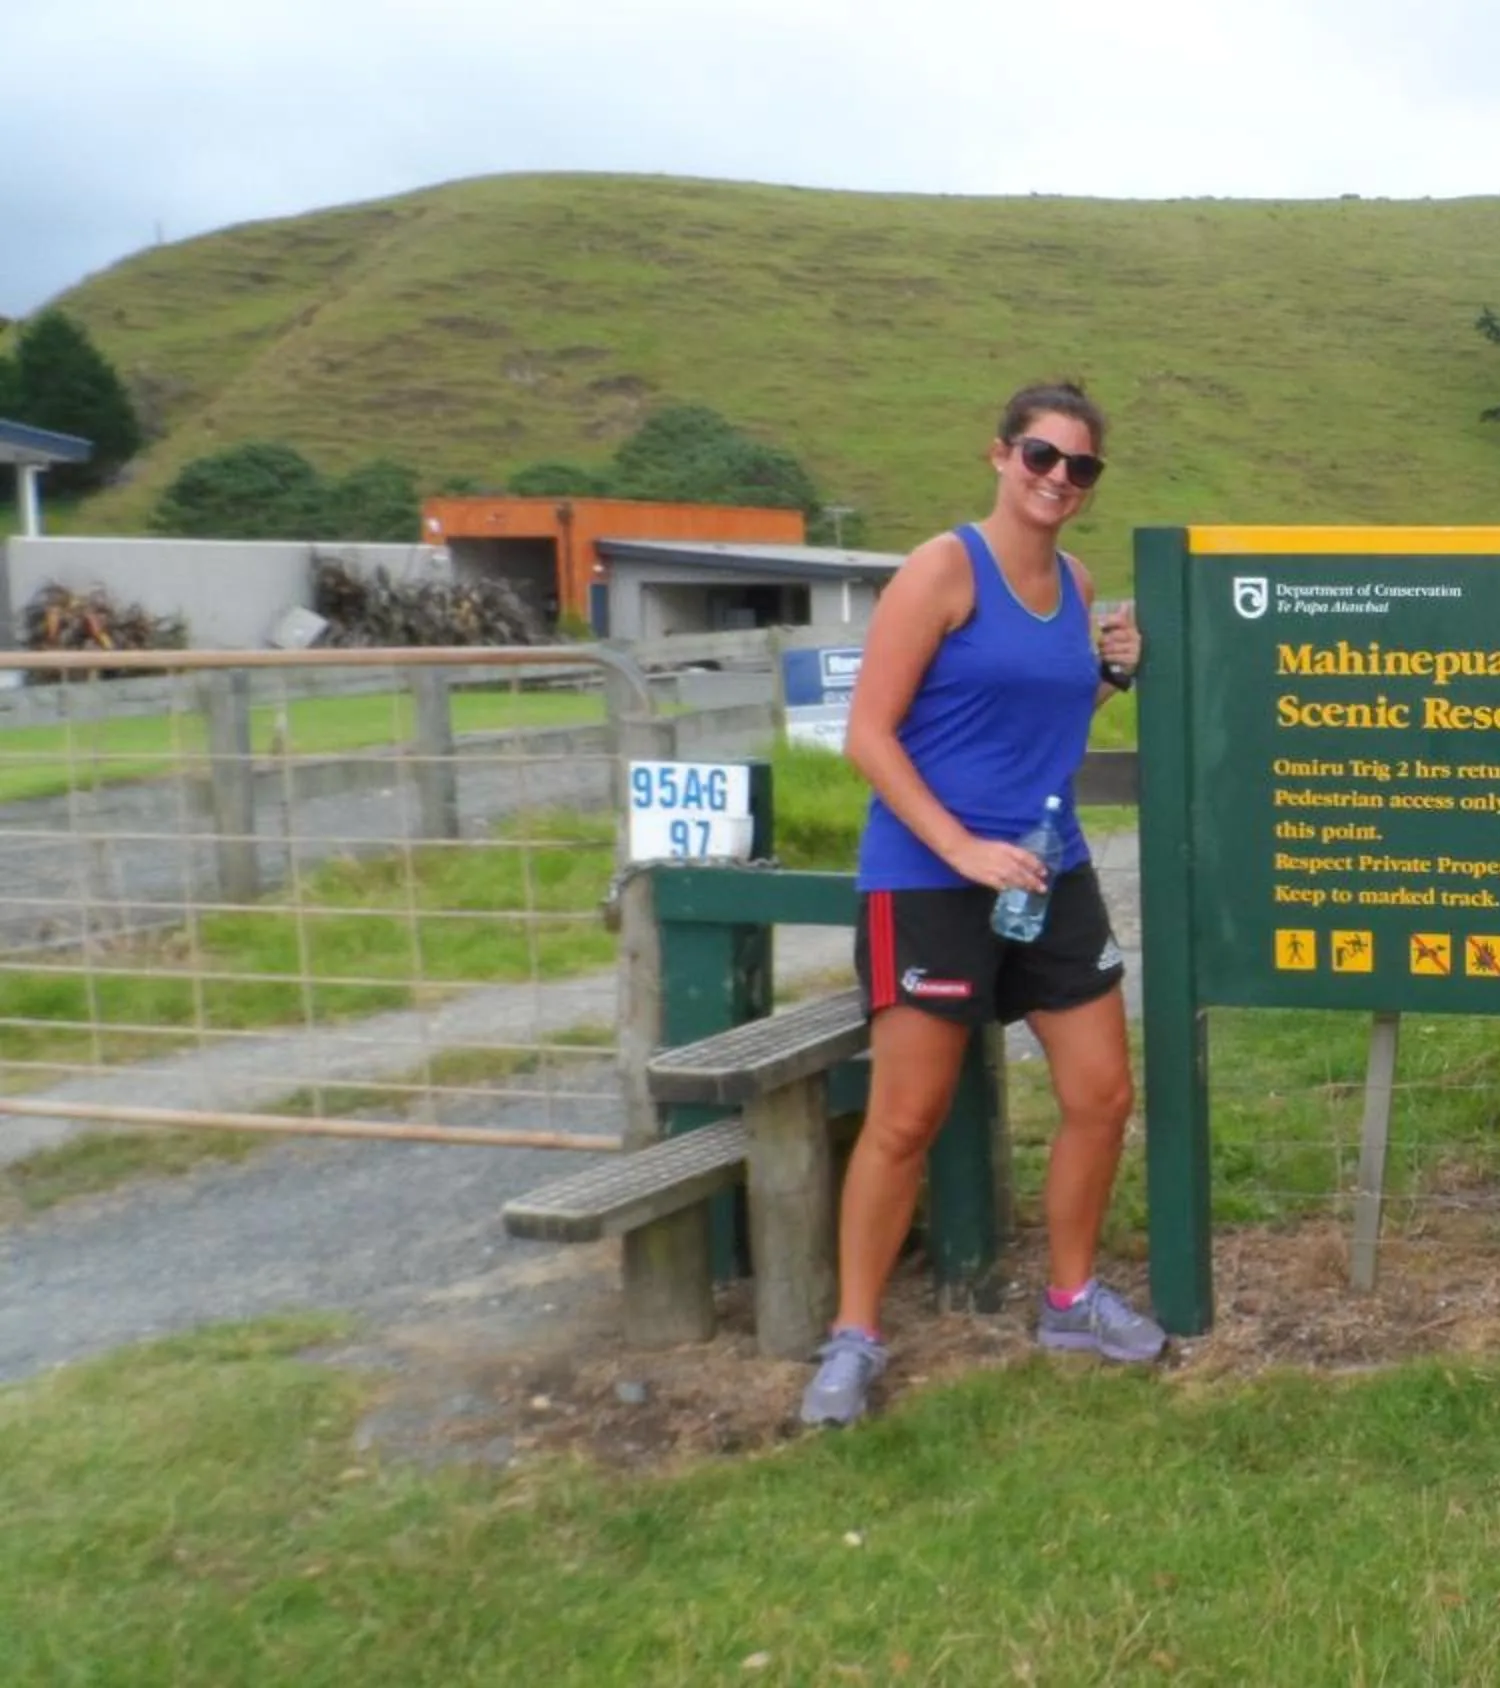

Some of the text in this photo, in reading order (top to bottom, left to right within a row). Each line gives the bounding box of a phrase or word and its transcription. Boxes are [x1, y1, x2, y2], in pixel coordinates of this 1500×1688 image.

[1276, 583, 1462, 599] Department of Conservation
[1277, 600, 1291, 613] Te
[1294, 601, 1328, 616] Papa
[1276, 694, 1410, 729] Scenic
[1273, 759, 1344, 778] Omiru
[1350, 760, 1391, 781] Trig
[1397, 761, 1409, 777] 2
[1415, 760, 1451, 779] hrs
[1274, 789, 1384, 809] Pedestrian
[1389, 793, 1454, 810] access
[670, 820, 710, 863] 97
[1275, 821, 1383, 843] this point.
[1274, 852, 1352, 874] Respect
[1359, 855, 1431, 873] Private
[1275, 885, 1500, 908] Keep to marked track.
